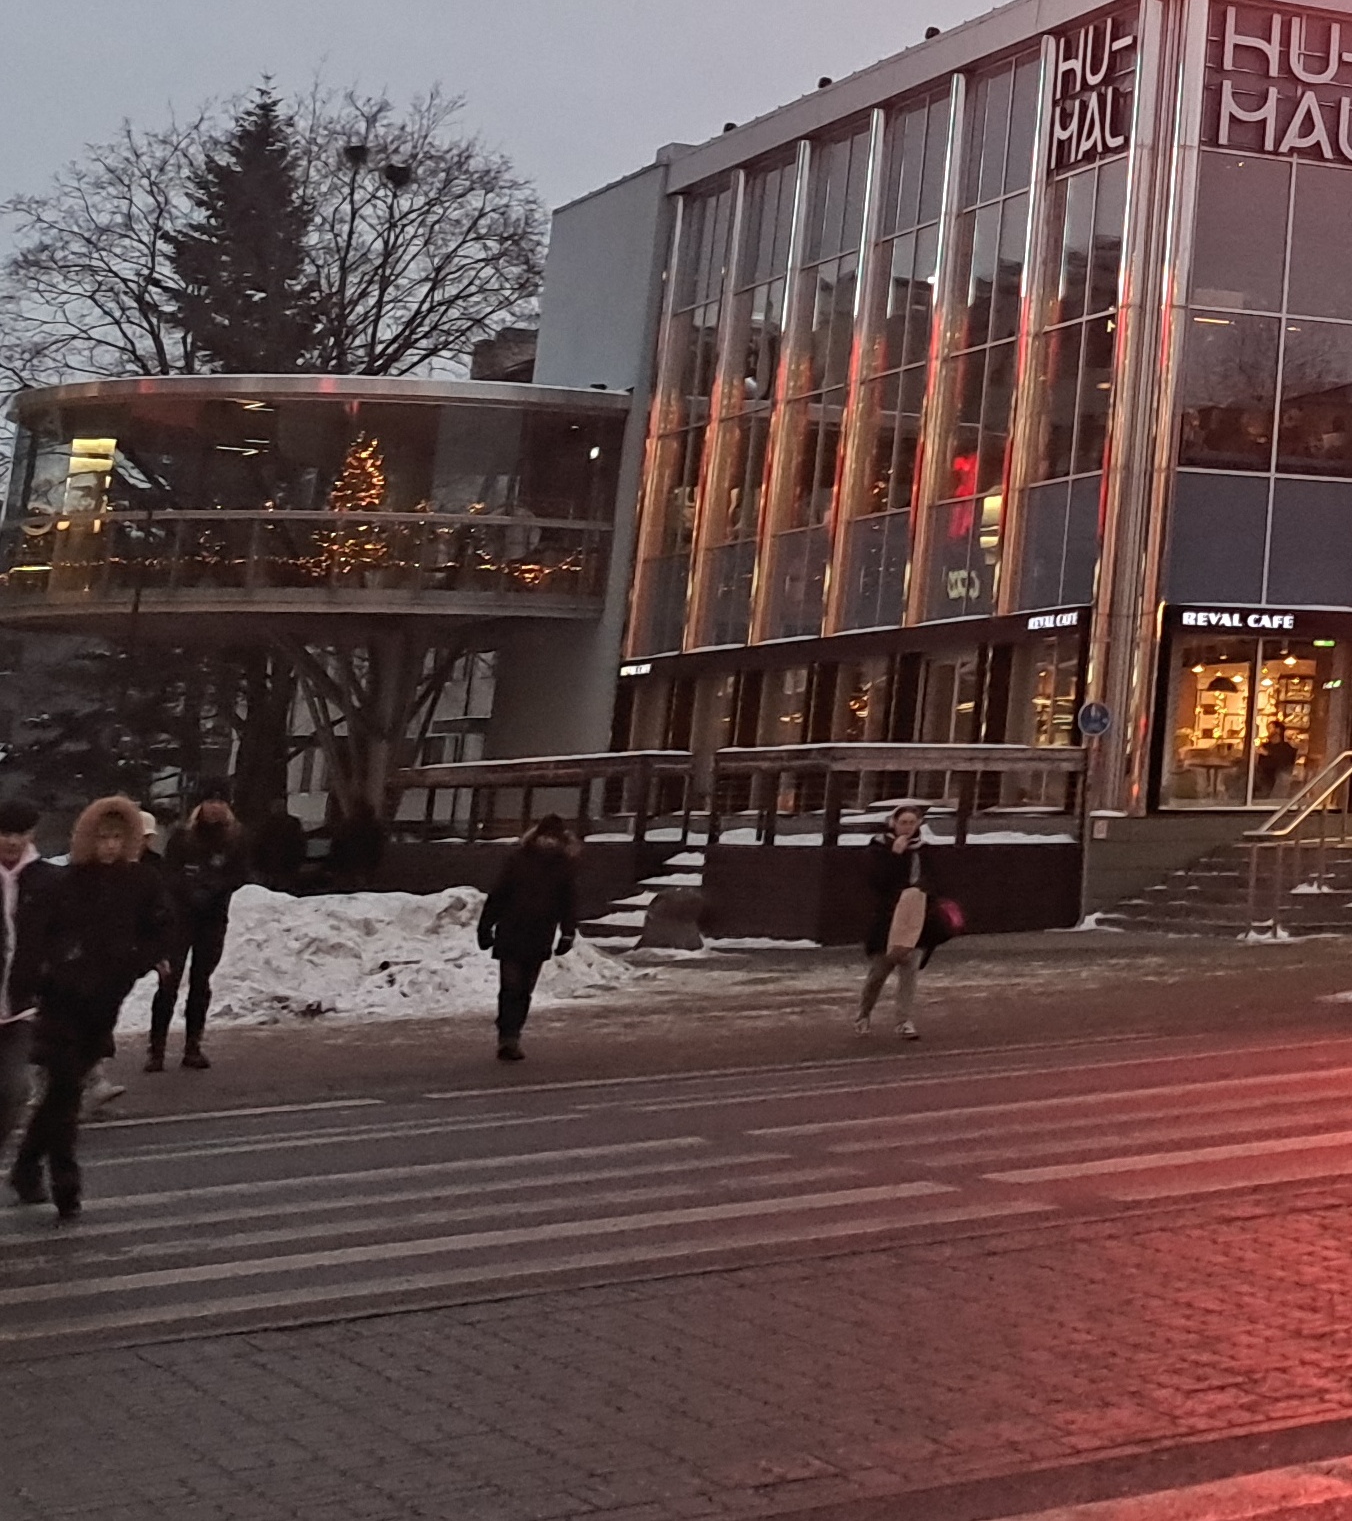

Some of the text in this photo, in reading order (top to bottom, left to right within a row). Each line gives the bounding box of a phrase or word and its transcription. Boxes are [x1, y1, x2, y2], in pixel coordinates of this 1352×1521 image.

[1055, 18, 1134, 99] HU-
[1050, 85, 1125, 169] MAL
[1182, 612, 1243, 627] REVAL
